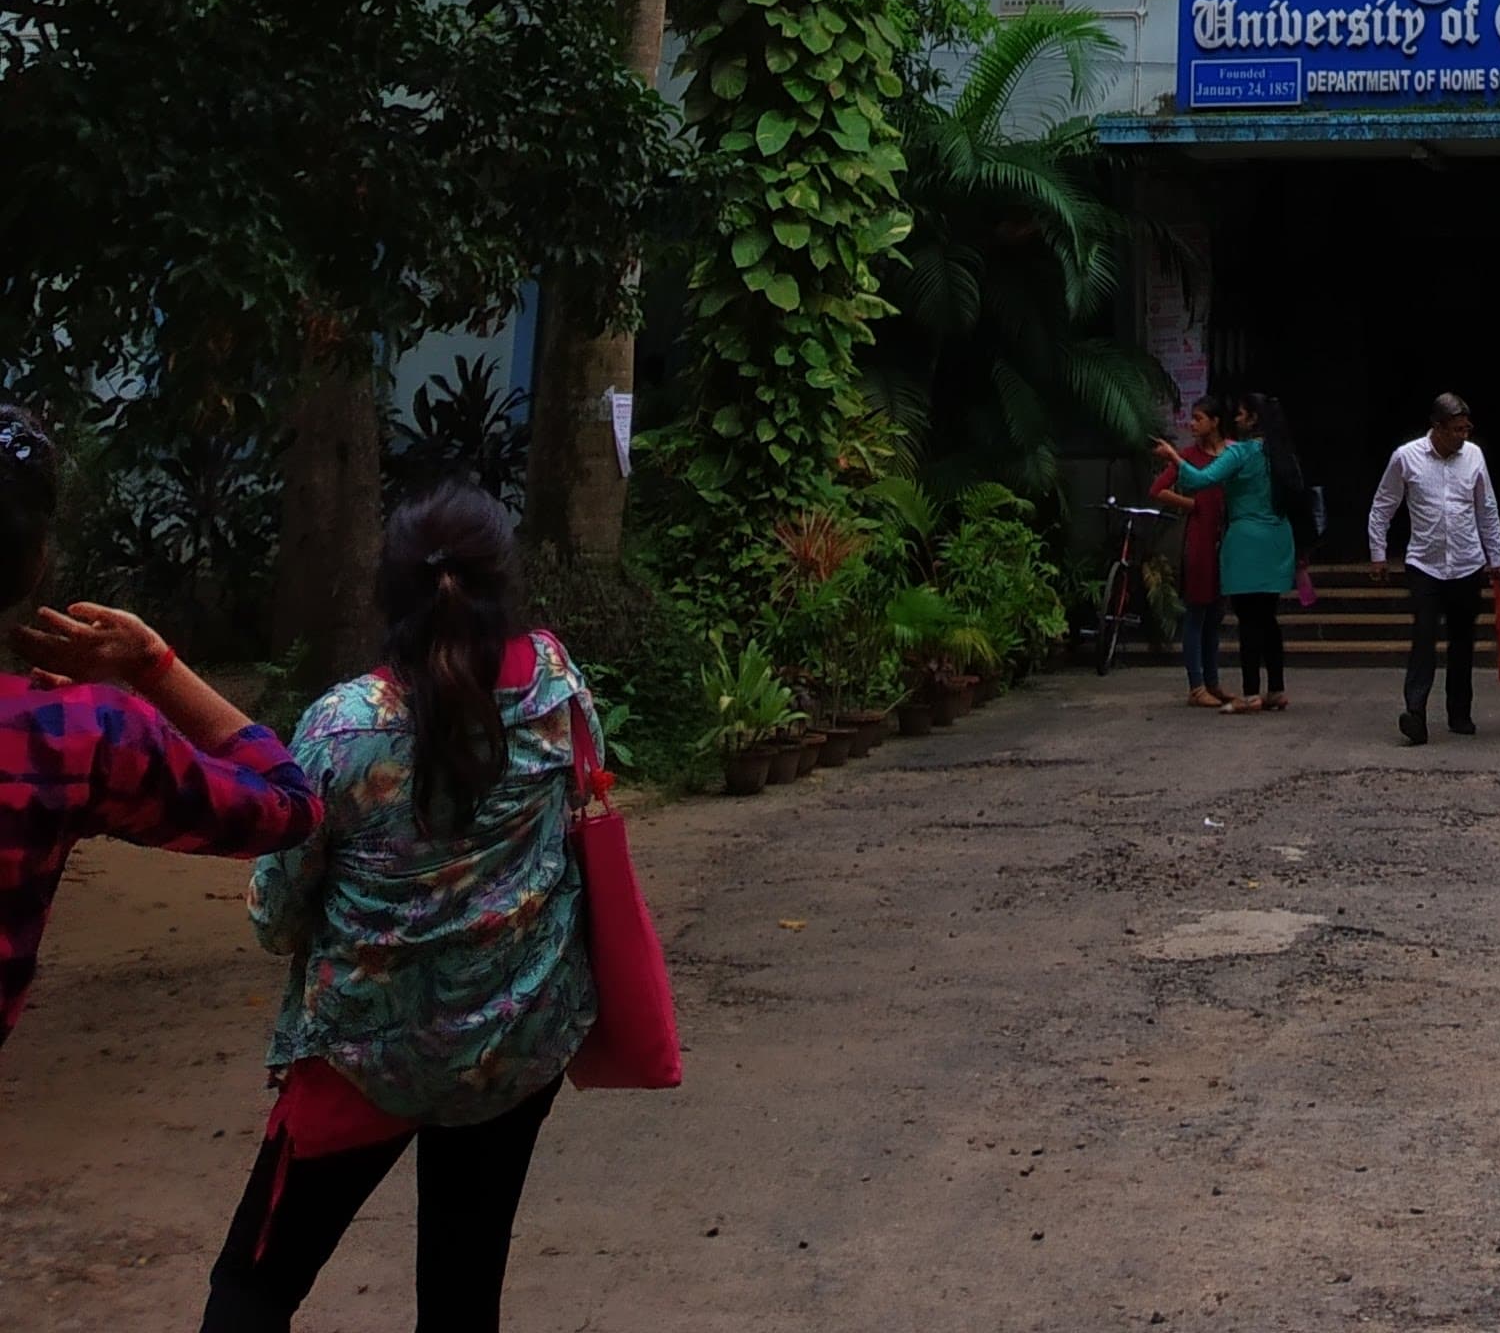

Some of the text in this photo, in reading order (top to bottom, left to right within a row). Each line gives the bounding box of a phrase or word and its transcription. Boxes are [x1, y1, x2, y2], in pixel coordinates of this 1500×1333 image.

[1219, 68, 1266, 79] Founded
[1307, 70, 1411, 93] DEPARTMENT
[1414, 69, 1436, 92] OF
[1440, 68, 1485, 91] HOME
[1195, 82, 1296, 98] January 24, 1857
